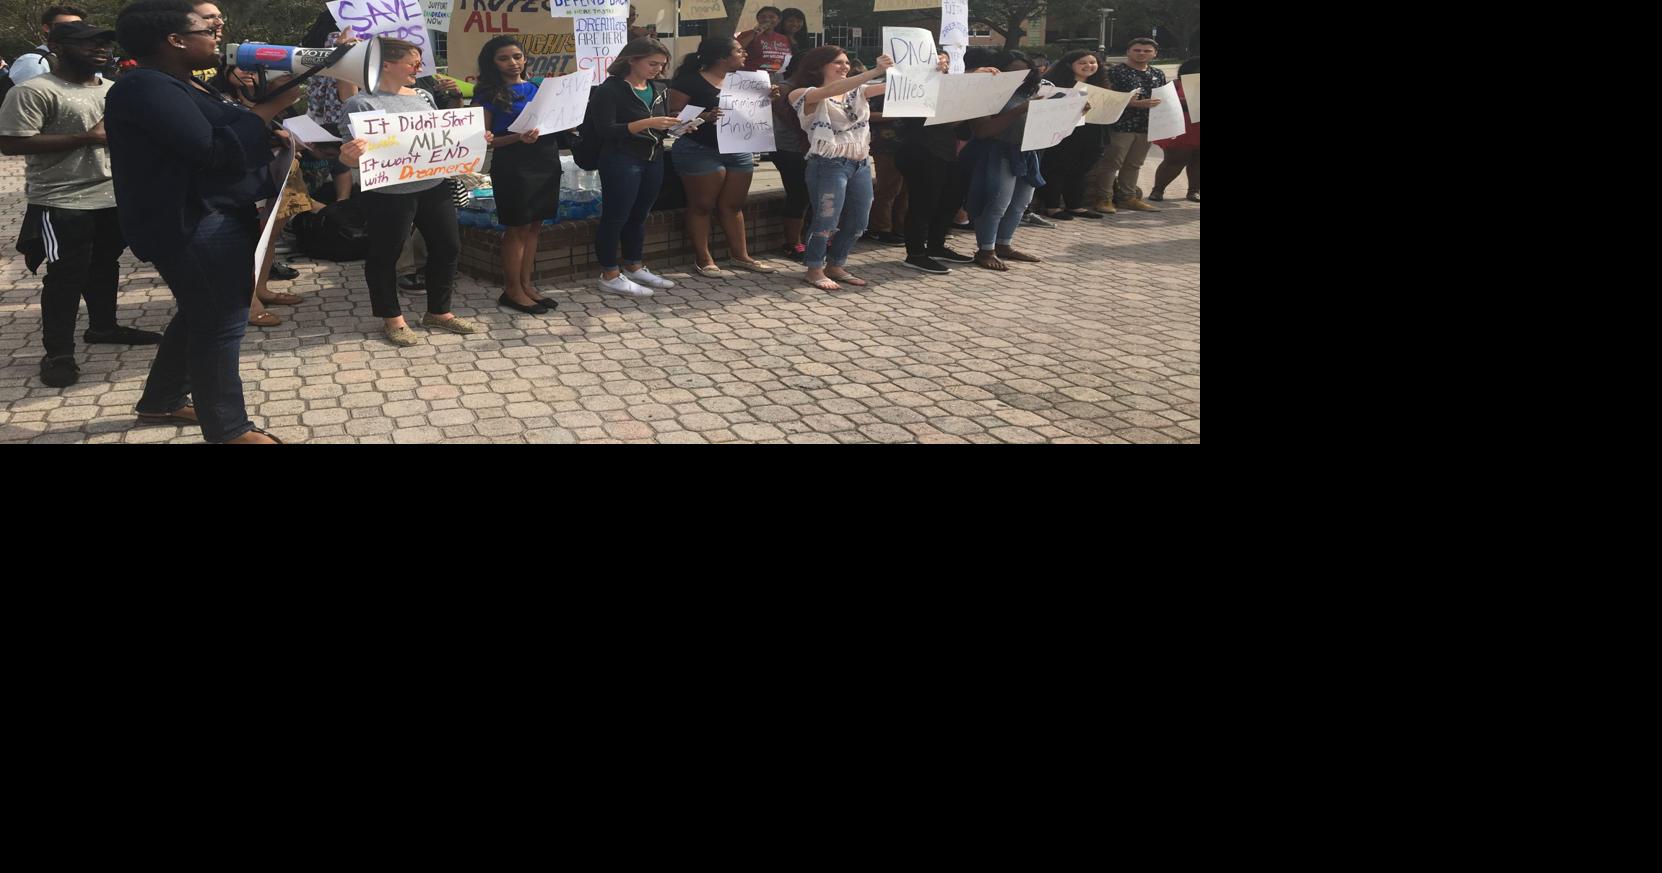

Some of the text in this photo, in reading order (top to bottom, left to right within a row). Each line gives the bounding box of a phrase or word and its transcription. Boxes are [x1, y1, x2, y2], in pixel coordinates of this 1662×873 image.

[338, 0, 422, 32] SAVE
[464, 11, 519, 32] ALL
[578, 31, 623, 45] ARE HERE
[592, 46, 610, 57] TO
[887, 74, 925, 102] Allies
[363, 110, 475, 135] It Didn't Start
[361, 160, 379, 173] It
[429, 146, 470, 164] END
[365, 172, 389, 186] with
